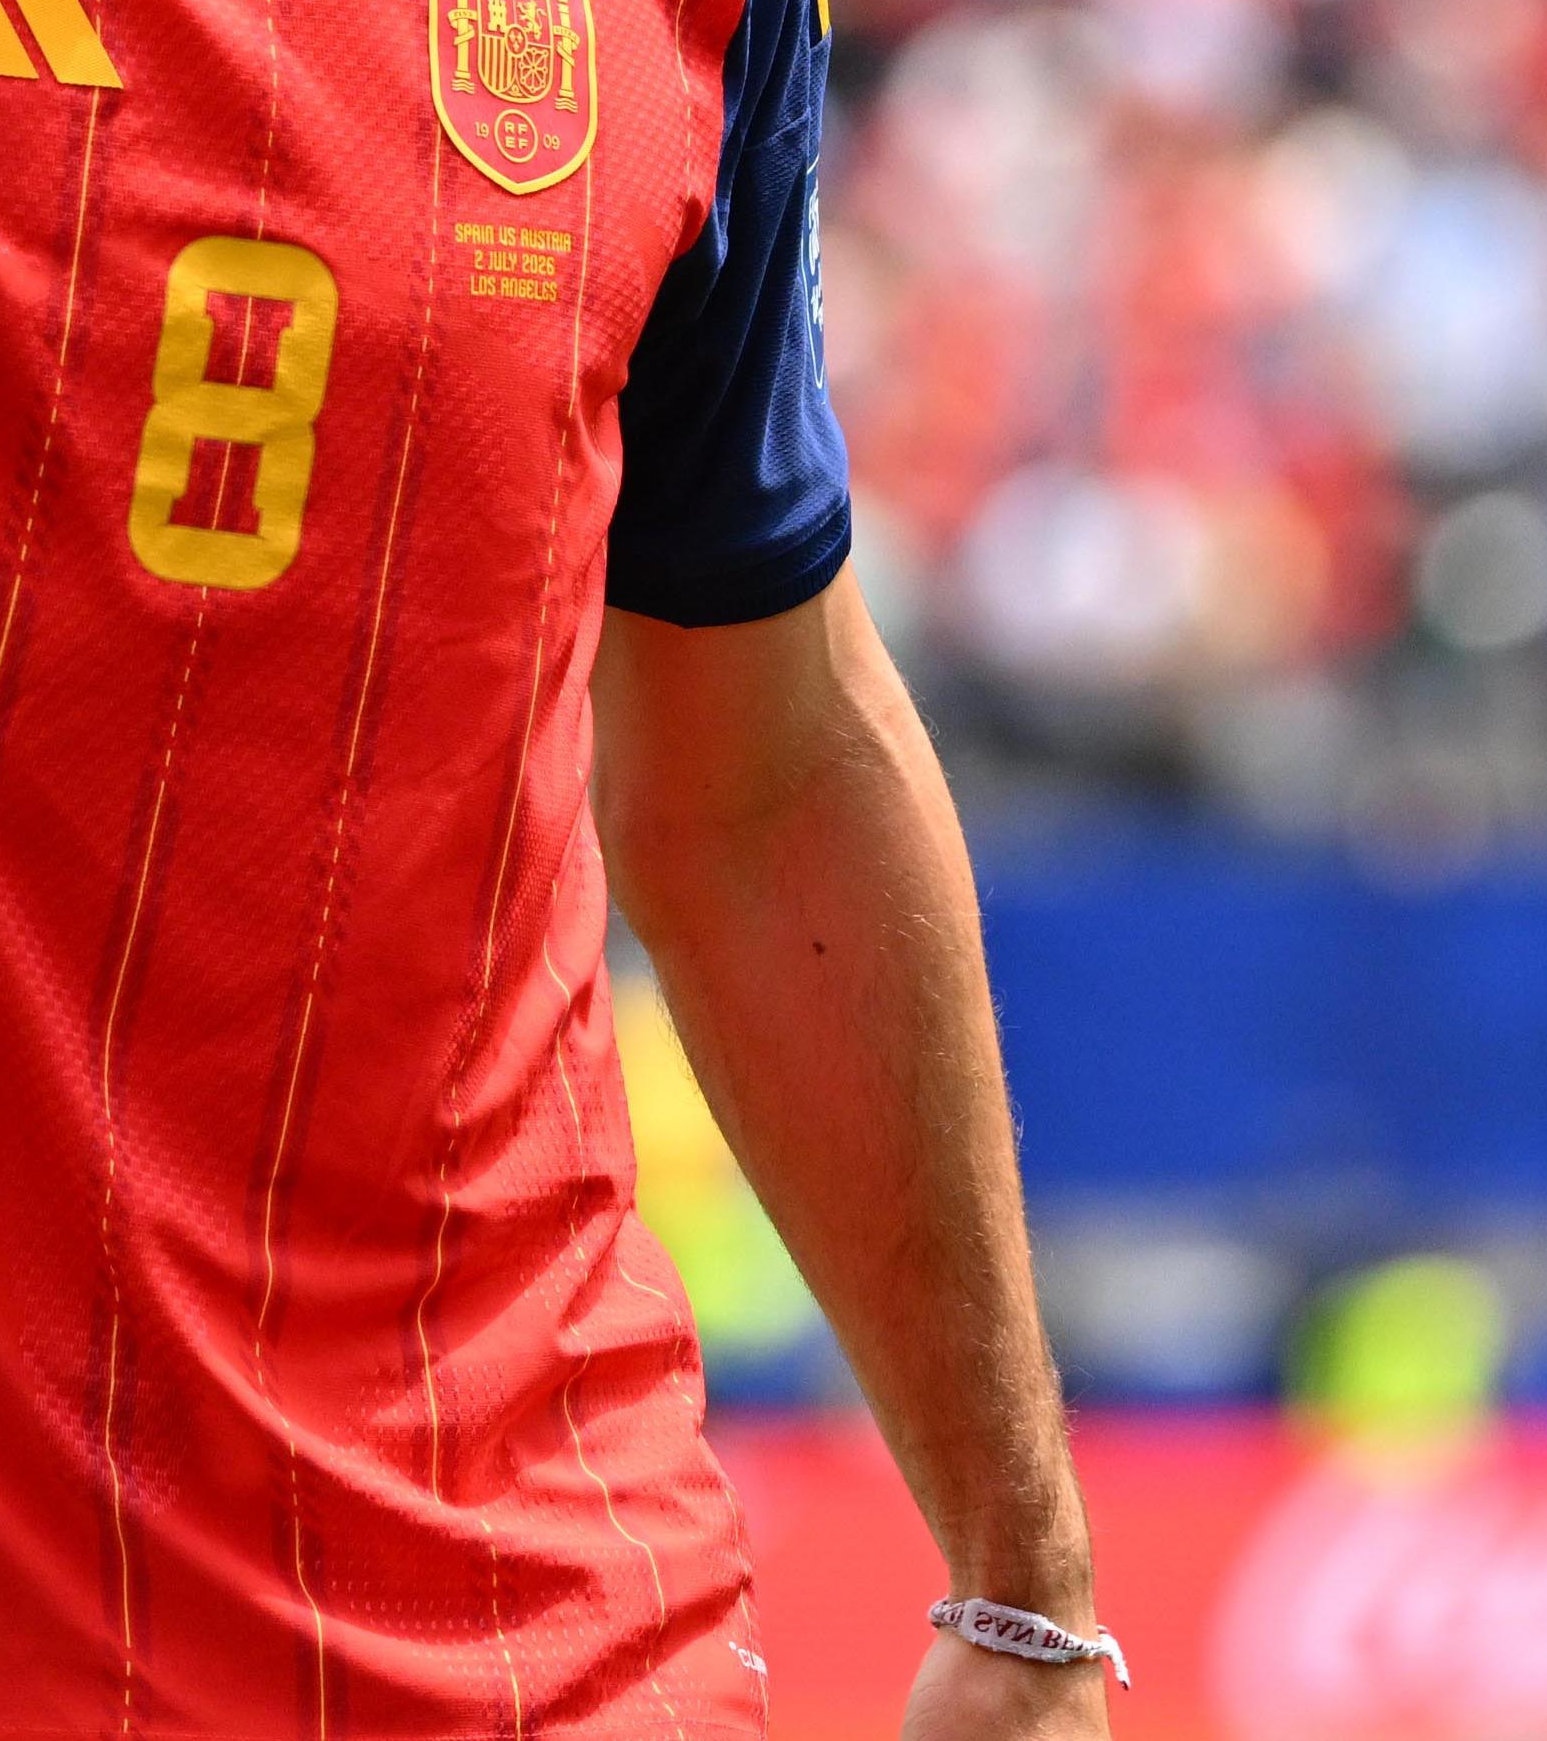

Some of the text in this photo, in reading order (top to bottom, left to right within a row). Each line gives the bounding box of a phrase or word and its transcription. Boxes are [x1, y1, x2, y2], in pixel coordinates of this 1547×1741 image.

[475, 122, 489, 138] 19
[543, 134, 560, 150] 09
[456, 224, 494, 243] SPAIN
[521, 229, 571, 252] AUSTRIA
[475, 250, 555, 275] 2 JULY 2026
[470, 274, 557, 301] LOS ANGELES
[128, 235, 338, 590] 8
